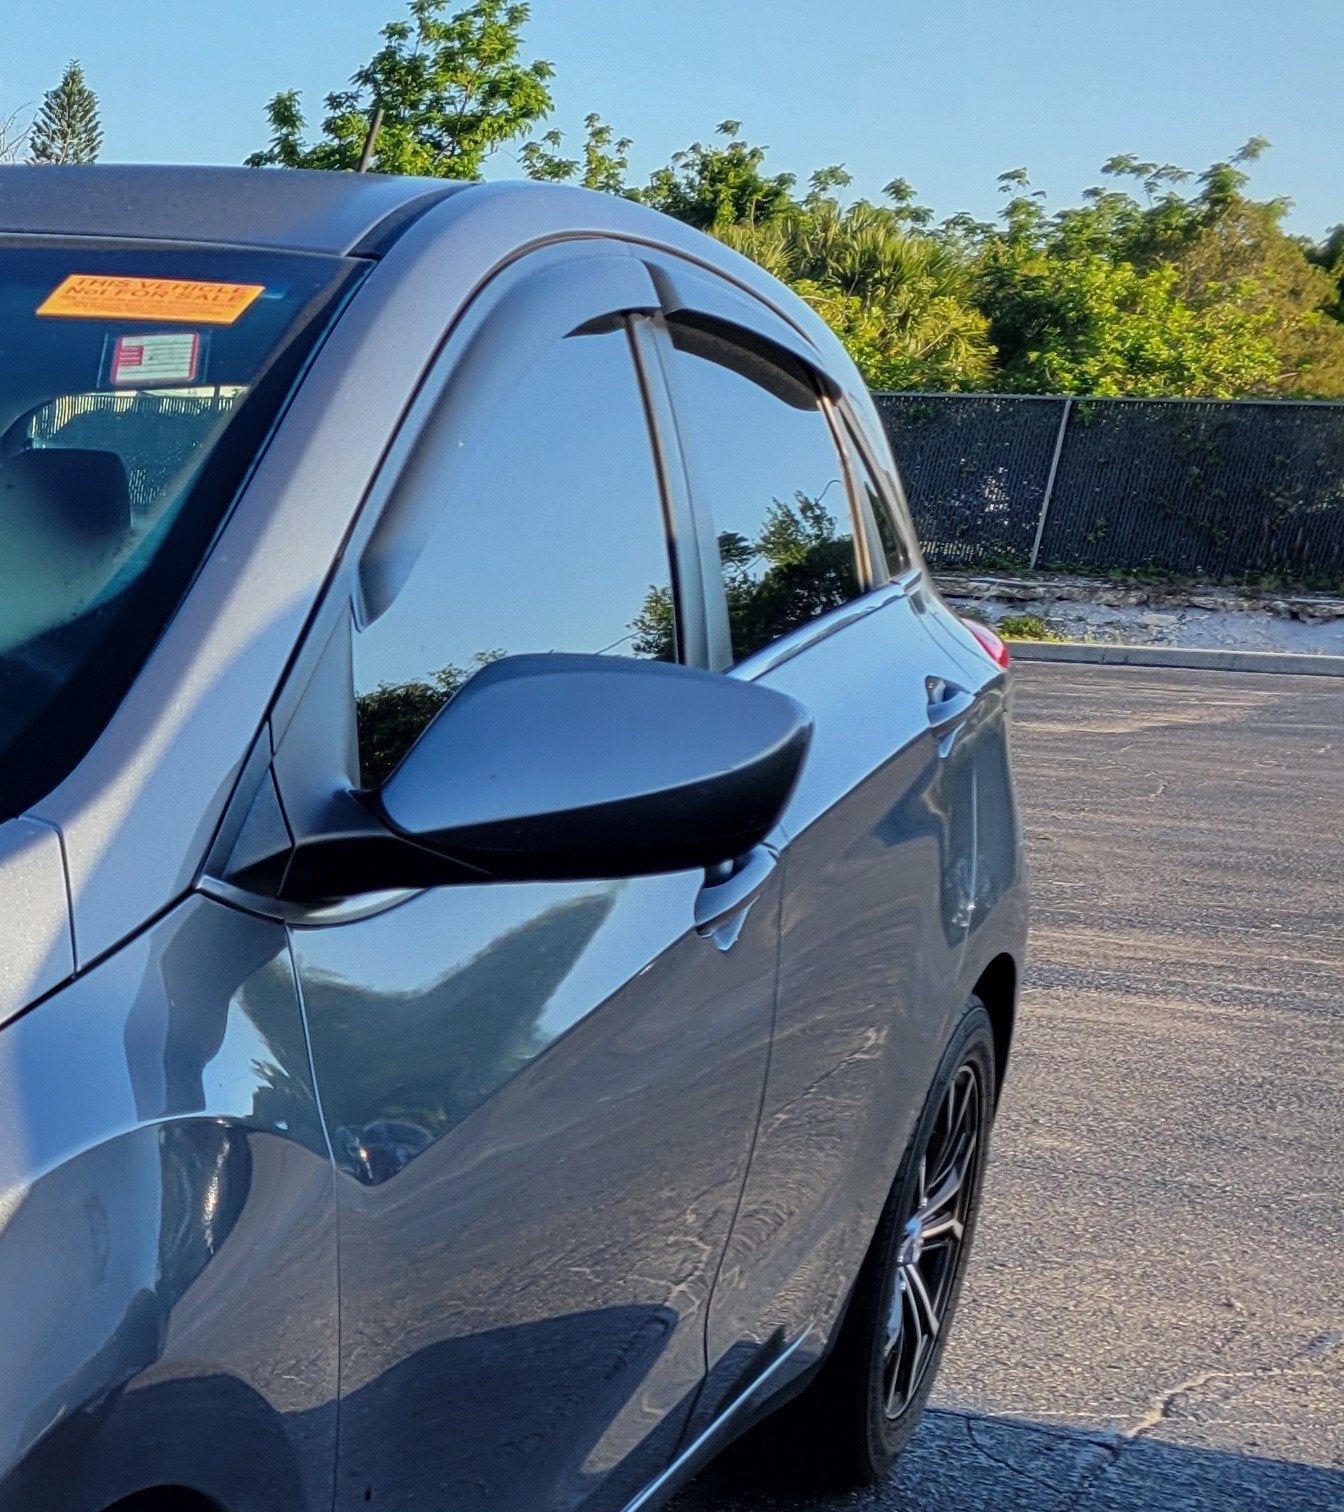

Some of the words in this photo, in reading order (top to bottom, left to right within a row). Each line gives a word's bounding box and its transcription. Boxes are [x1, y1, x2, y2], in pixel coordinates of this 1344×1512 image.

[77, 278, 131, 288] THIS
[140, 280, 248, 295] VEHICLE
[113, 287, 168, 299] FOR
[176, 290, 247, 303] SALE
